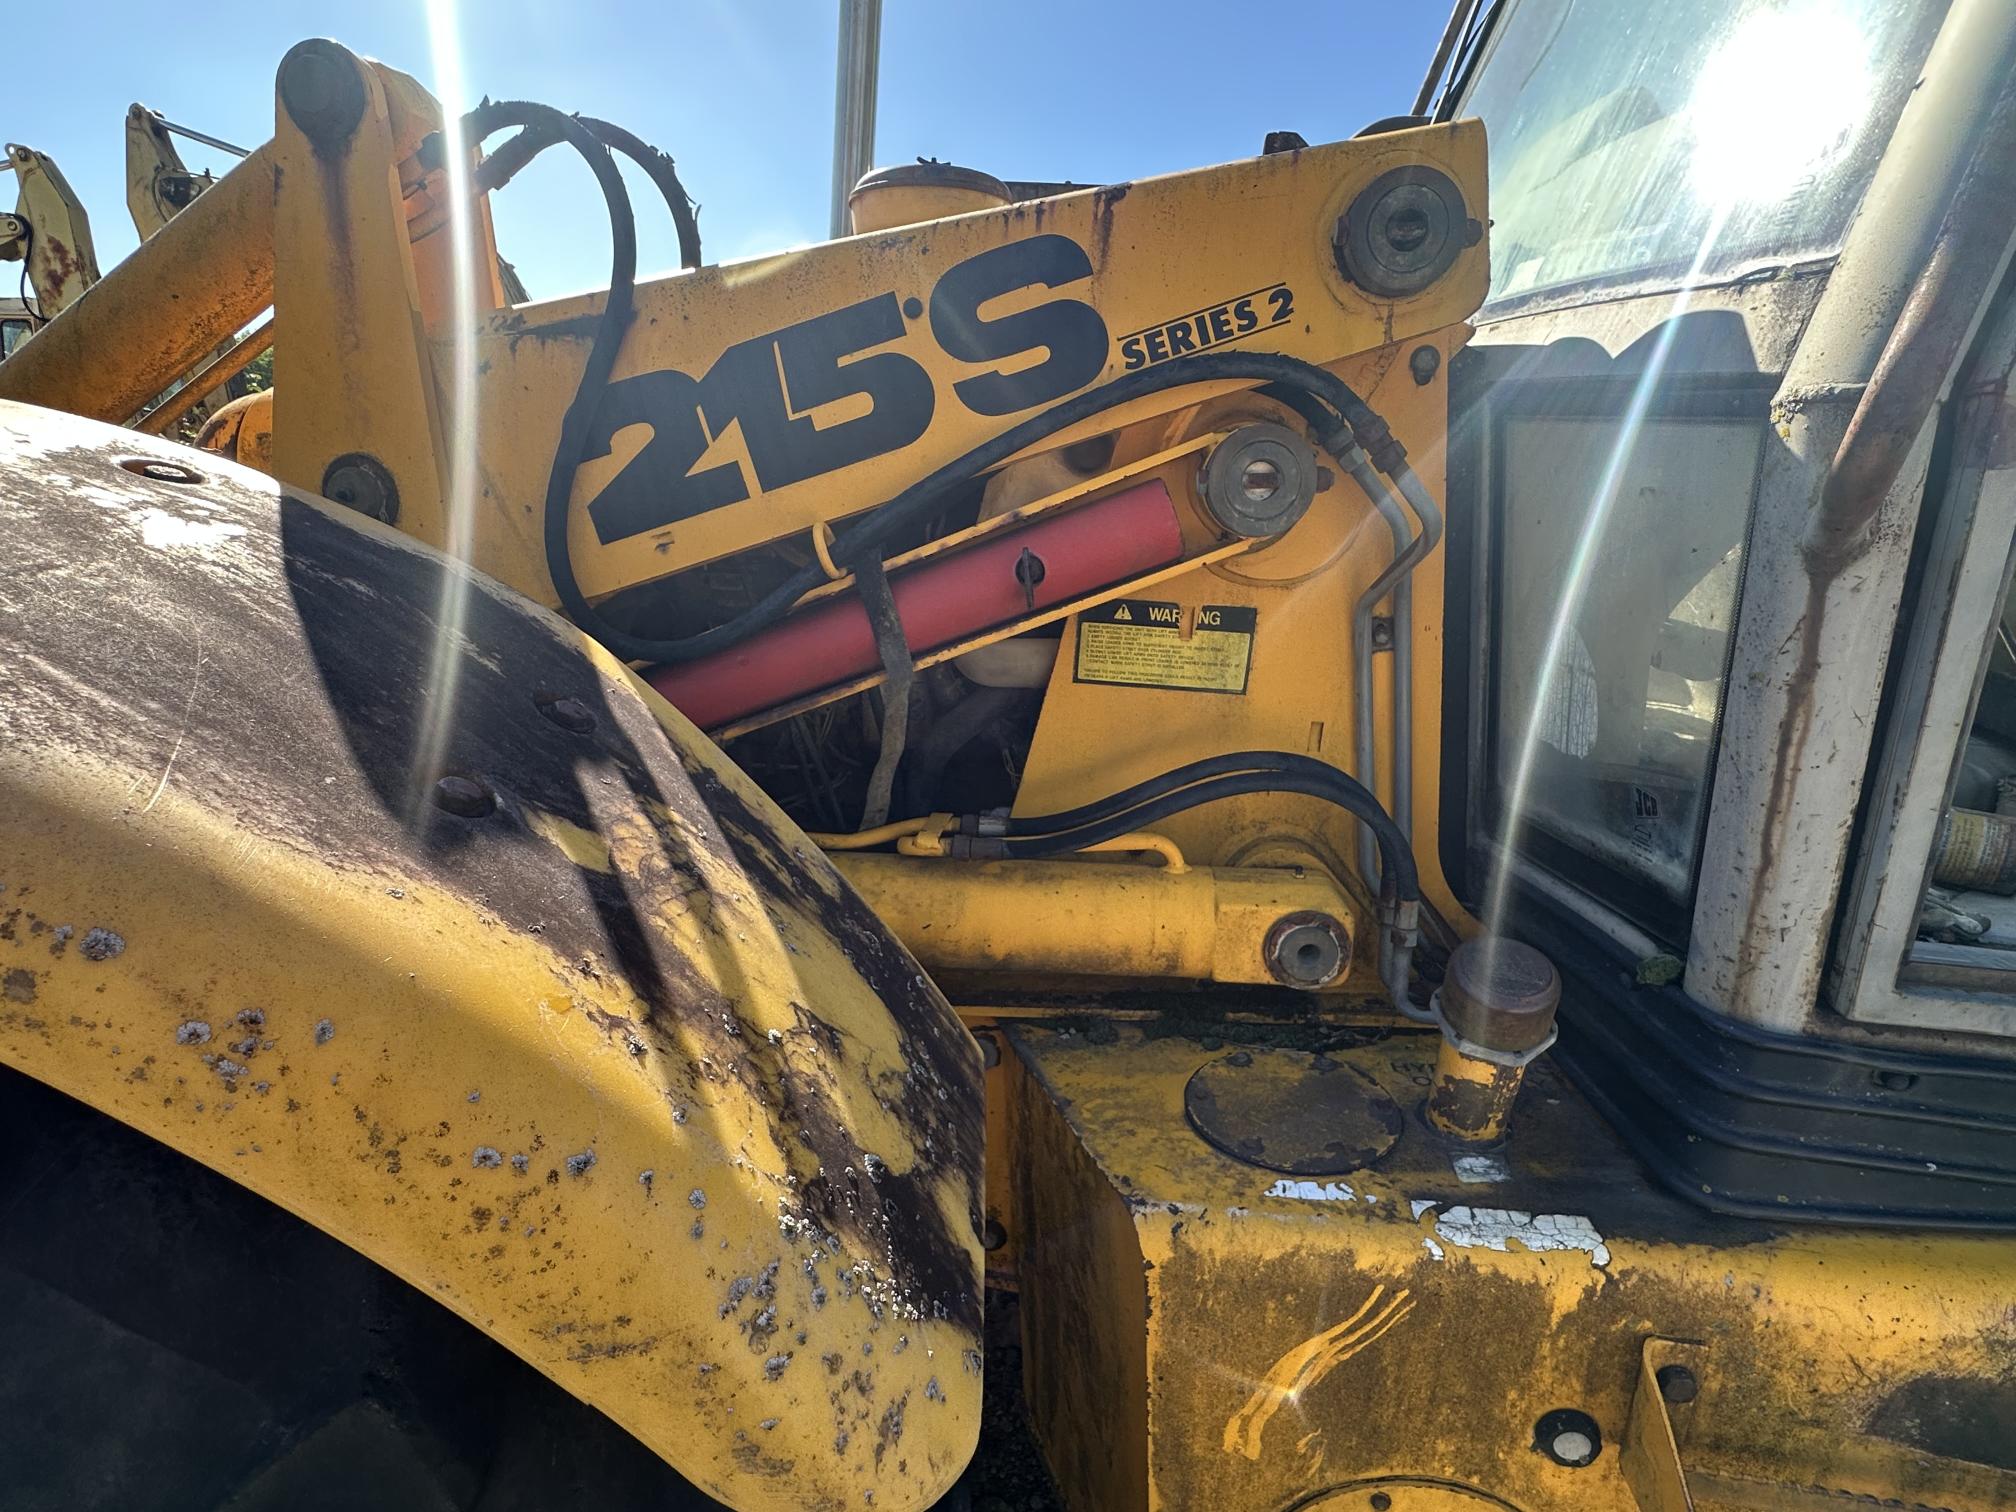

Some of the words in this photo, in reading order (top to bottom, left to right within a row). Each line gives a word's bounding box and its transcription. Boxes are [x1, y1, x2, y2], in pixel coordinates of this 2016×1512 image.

[1122, 299, 1259, 370] SERIES
[1267, 289, 1295, 323] 2
[1148, 607, 1221, 627] WARNG
